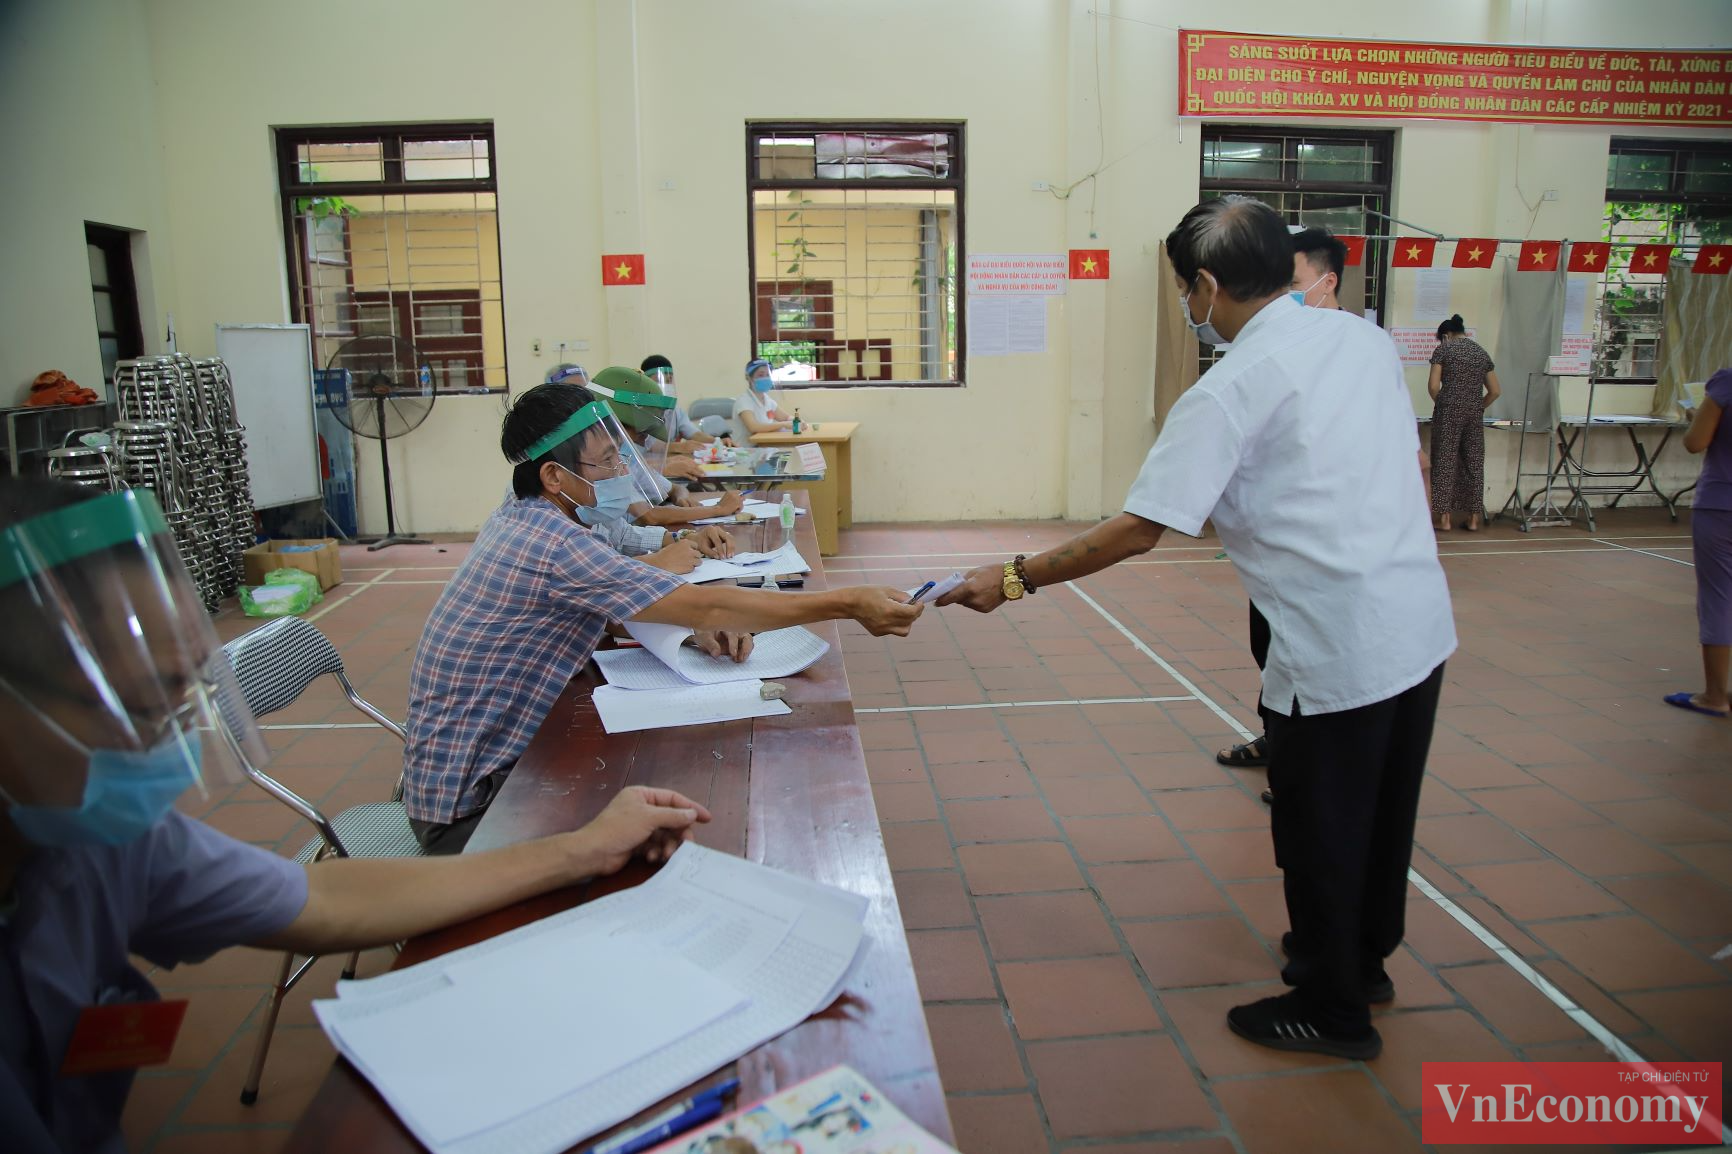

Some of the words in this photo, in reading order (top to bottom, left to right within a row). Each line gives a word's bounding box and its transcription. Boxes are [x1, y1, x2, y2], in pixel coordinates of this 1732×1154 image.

[1229, 45, 1273, 59] SÁNG
[1278, 43, 1319, 60] SUỐT
[1323, 47, 1352, 63] LỰA
[1357, 49, 1399, 65] CHỌN
[1405, 49, 1458, 65] NHỮNG
[1463, 52, 1509, 68] NGƯỜI
[1513, 53, 1546, 69] TIÊU
[1550, 51, 1584, 70] BIỂU
[1589, 53, 1607, 70] VỀ
[1610, 55, 1643, 72] ĐỨC,
[1649, 57, 1675, 73] TÀI,
[1680, 57, 1720, 73] XỨNG
[1196, 68, 1223, 84] ĐẠI
[1229, 68, 1265, 84] DIỆN
[1271, 70, 1302, 83] CHO
[1307, 67, 1316, 83] Ý
[1322, 69, 1351, 85] CHÍ,
[1357, 70, 1418, 88] NGUYỆN
[1424, 73, 1464, 88] VỌNG
[1469, 73, 1488, 88] VÀ
[1493, 73, 1541, 90] QUYỀN
[1546, 75, 1577, 92] LÀM
[1582, 75, 1611, 92] CHỦ
[1616, 75, 1645, 93] CỦA
[1649, 79, 1691, 94] NHÂN
[1694, 79, 1724, 95] DÂN
[1214, 87, 1256, 105] QUỐC
[1261, 89, 1287, 106] HỘI
[1292, 90, 1334, 106] KHÓA
[1339, 93, 1359, 106] XV
[1364, 91, 1383, 107] VÀ
[1388, 92, 1413, 111] HỘI
[1418, 92, 1459, 108] ĐỒNG
[1465, 96, 1506, 111] NHÂN
[1511, 97, 1541, 113] DÂN
[1546, 97, 1575, 113] CÁC
[1580, 97, 1609, 114] CẤP
[1613, 101, 1661, 117] NHIỆM
[1665, 101, 1684, 116] KỲ
[1688, 103, 1721, 117] 2021
